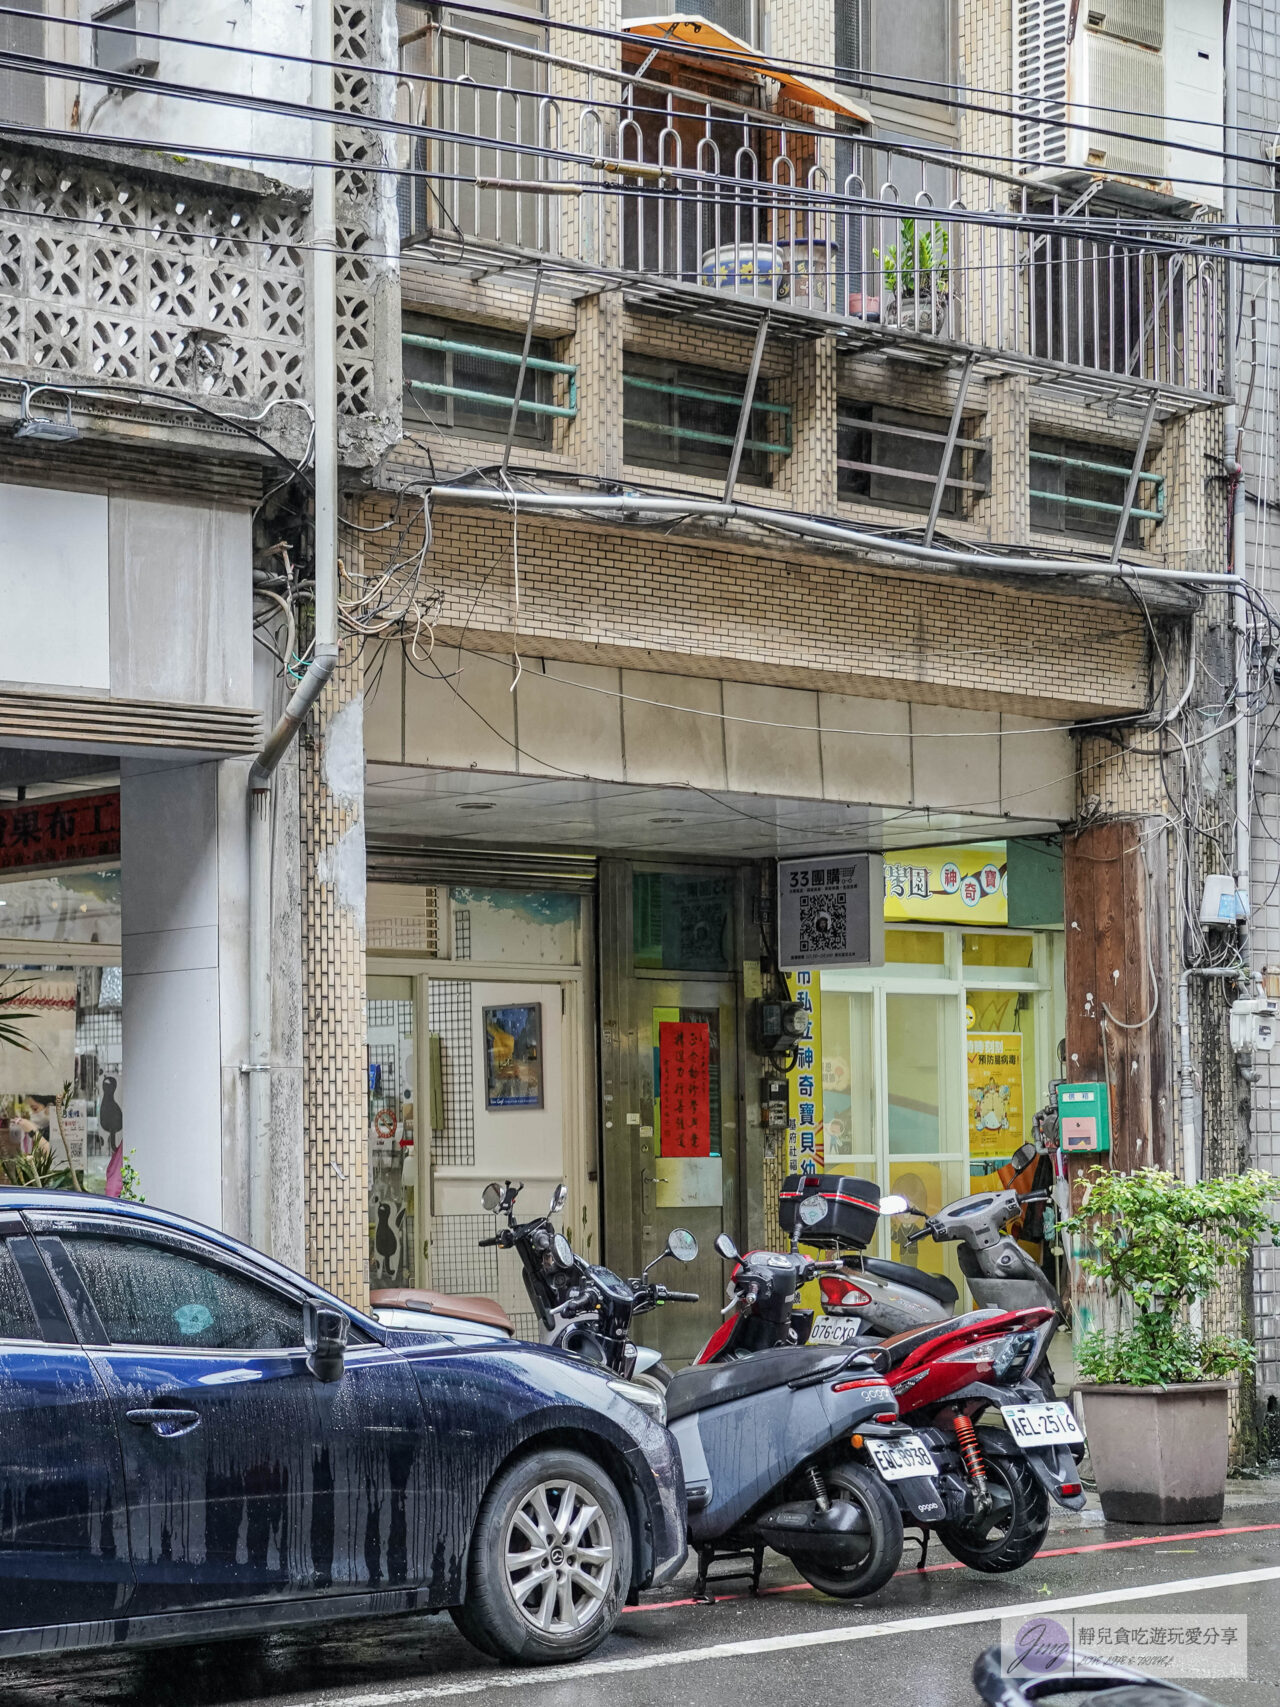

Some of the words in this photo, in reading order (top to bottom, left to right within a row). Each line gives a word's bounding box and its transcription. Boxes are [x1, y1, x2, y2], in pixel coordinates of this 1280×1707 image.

[789, 867, 840, 888] 33團購
[884, 864, 930, 898] 學園
[789, 1118, 797, 1174] 基府社福
